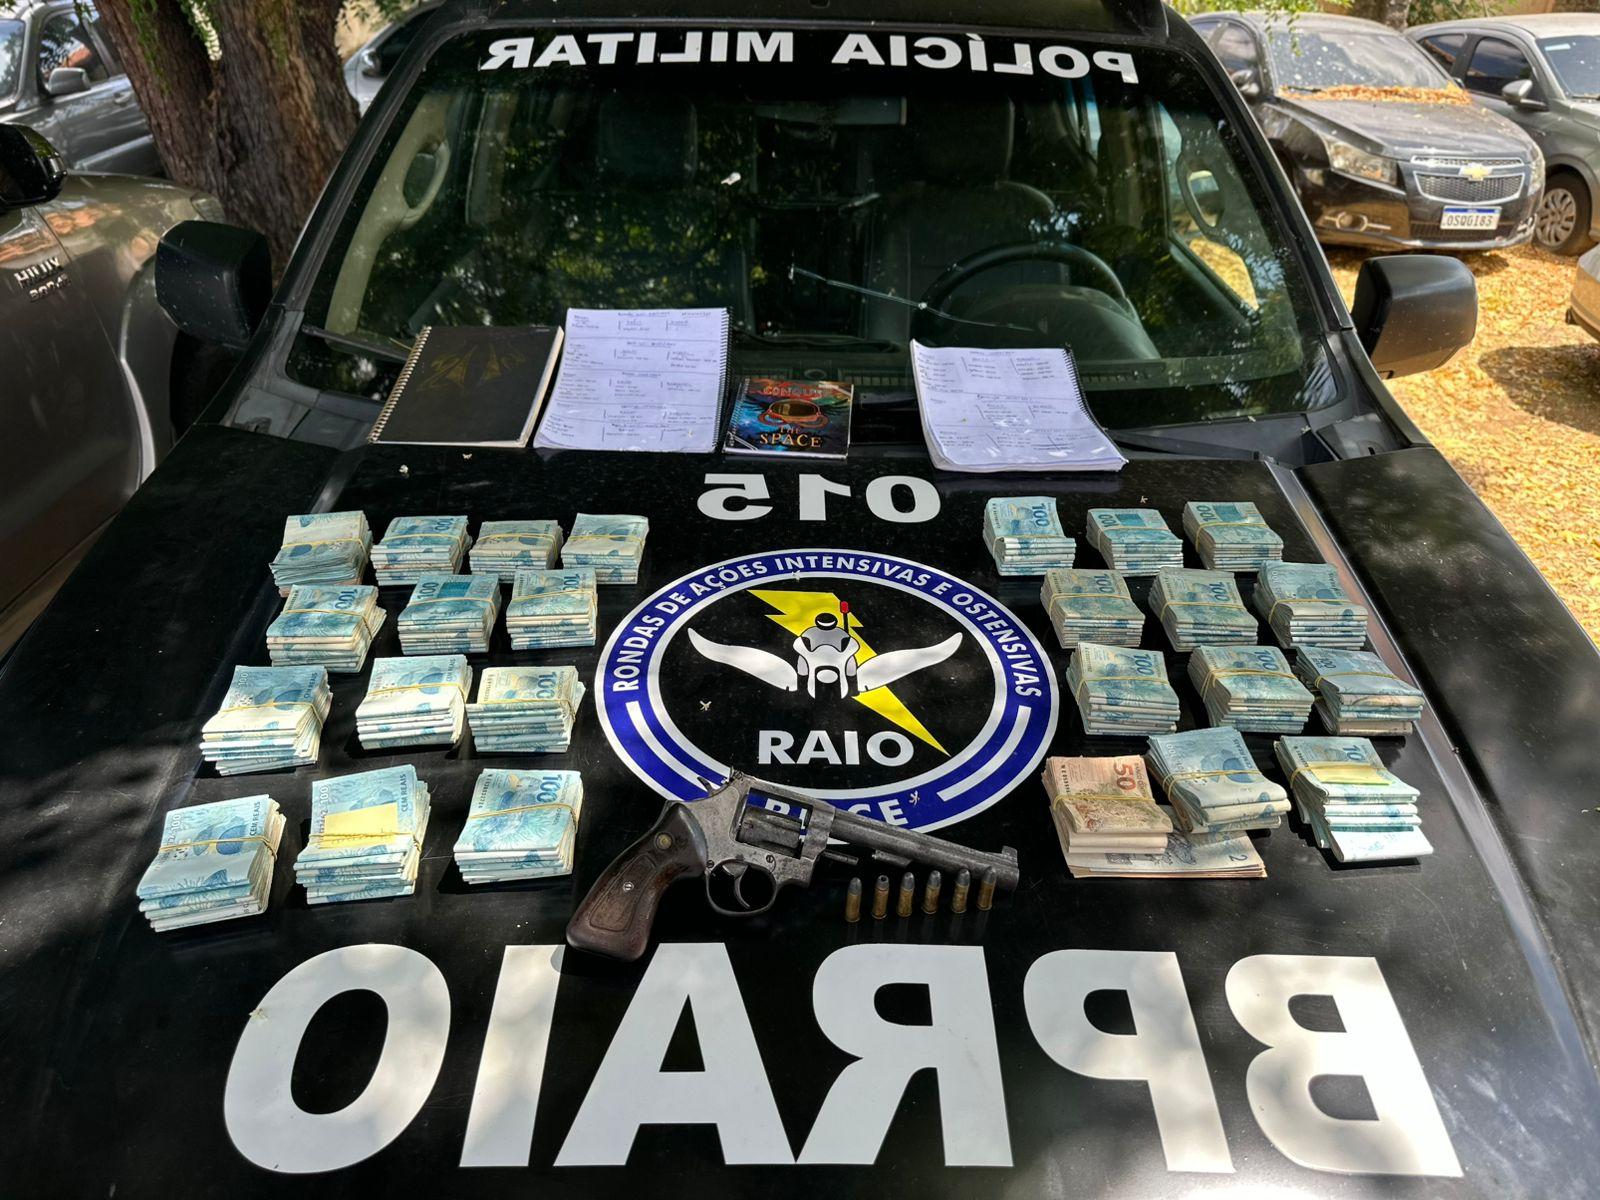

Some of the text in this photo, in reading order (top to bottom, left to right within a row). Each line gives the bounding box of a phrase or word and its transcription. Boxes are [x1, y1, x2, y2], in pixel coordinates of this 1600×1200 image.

[760, 433, 822, 448] SPACE
[1032, 503, 1050, 528] 100
[1196, 504, 1216, 522] 100
[613, 612, 663, 691] RONDAS
[660, 591, 692, 616] DE
[692, 560, 768, 598] AÇÕES
[775, 555, 931, 586] INTENSIVAS
[933, 581, 952, 597] E
[953, 592, 1042, 698] OSTENSIVAS
[1133, 654, 1154, 675] 100
[1254, 649, 1279, 671] 100
[758, 730, 915, 766] RAIO
[536, 773, 560, 803] 100
[1114, 762, 1137, 790] 50
